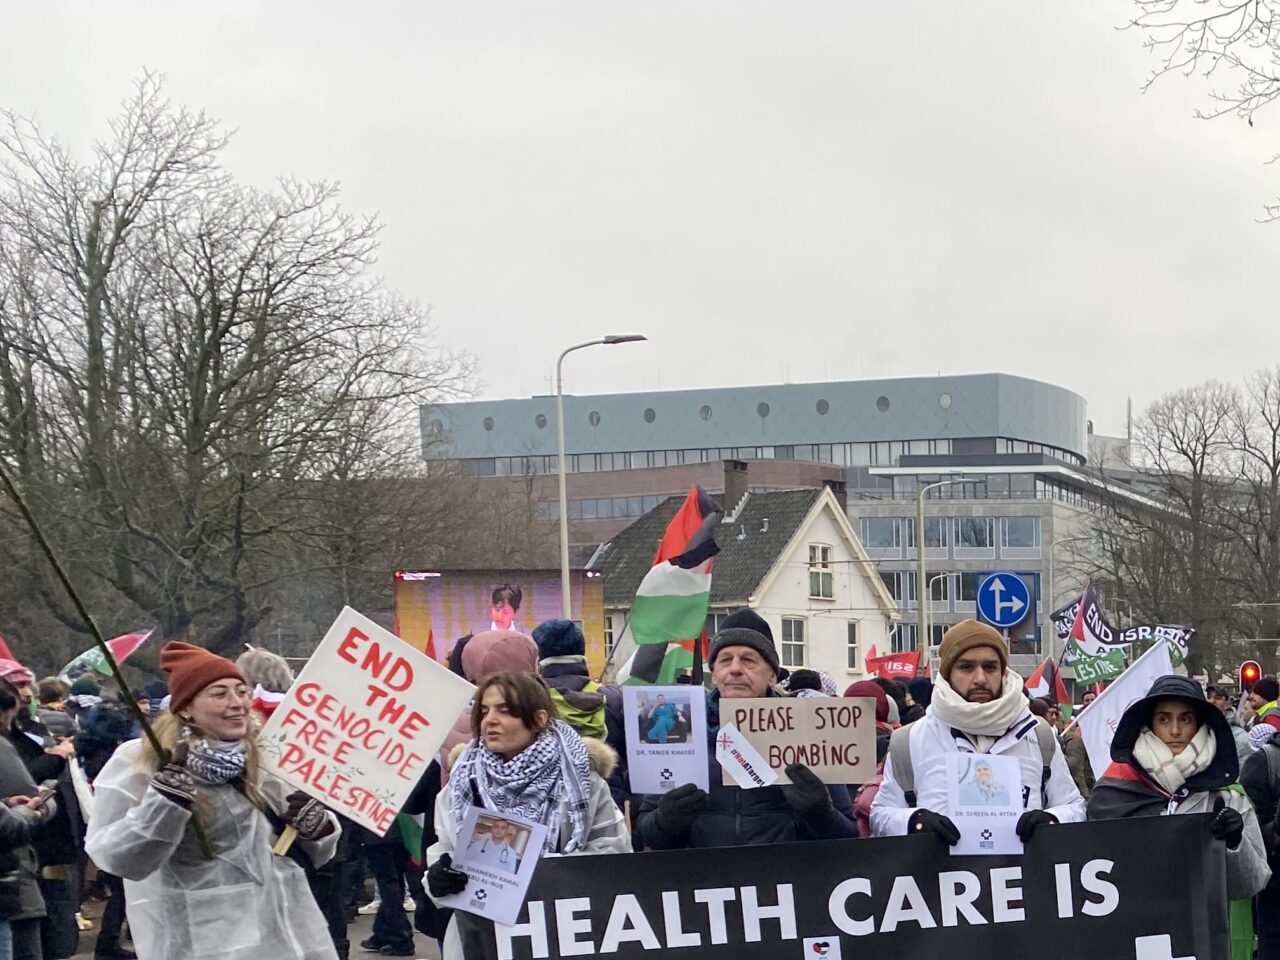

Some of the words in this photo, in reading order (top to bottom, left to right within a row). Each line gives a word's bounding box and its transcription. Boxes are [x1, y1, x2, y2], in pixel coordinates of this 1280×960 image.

[1085, 602, 1113, 642] END
[337, 627, 413, 692] END
[281, 709, 355, 765] FREE
[295, 683, 424, 780] GENOCIDE
[366, 685, 430, 740] THE
[735, 706, 795, 732] PLEASE
[815, 706, 862, 729] STOP
[278, 743, 397, 832] PALESTINE
[731, 749, 765, 787] #NotATarget
[493, 884, 798, 960] HEALTH
[828, 866, 1026, 936] CARE
[1054, 858, 1120, 919] IS
